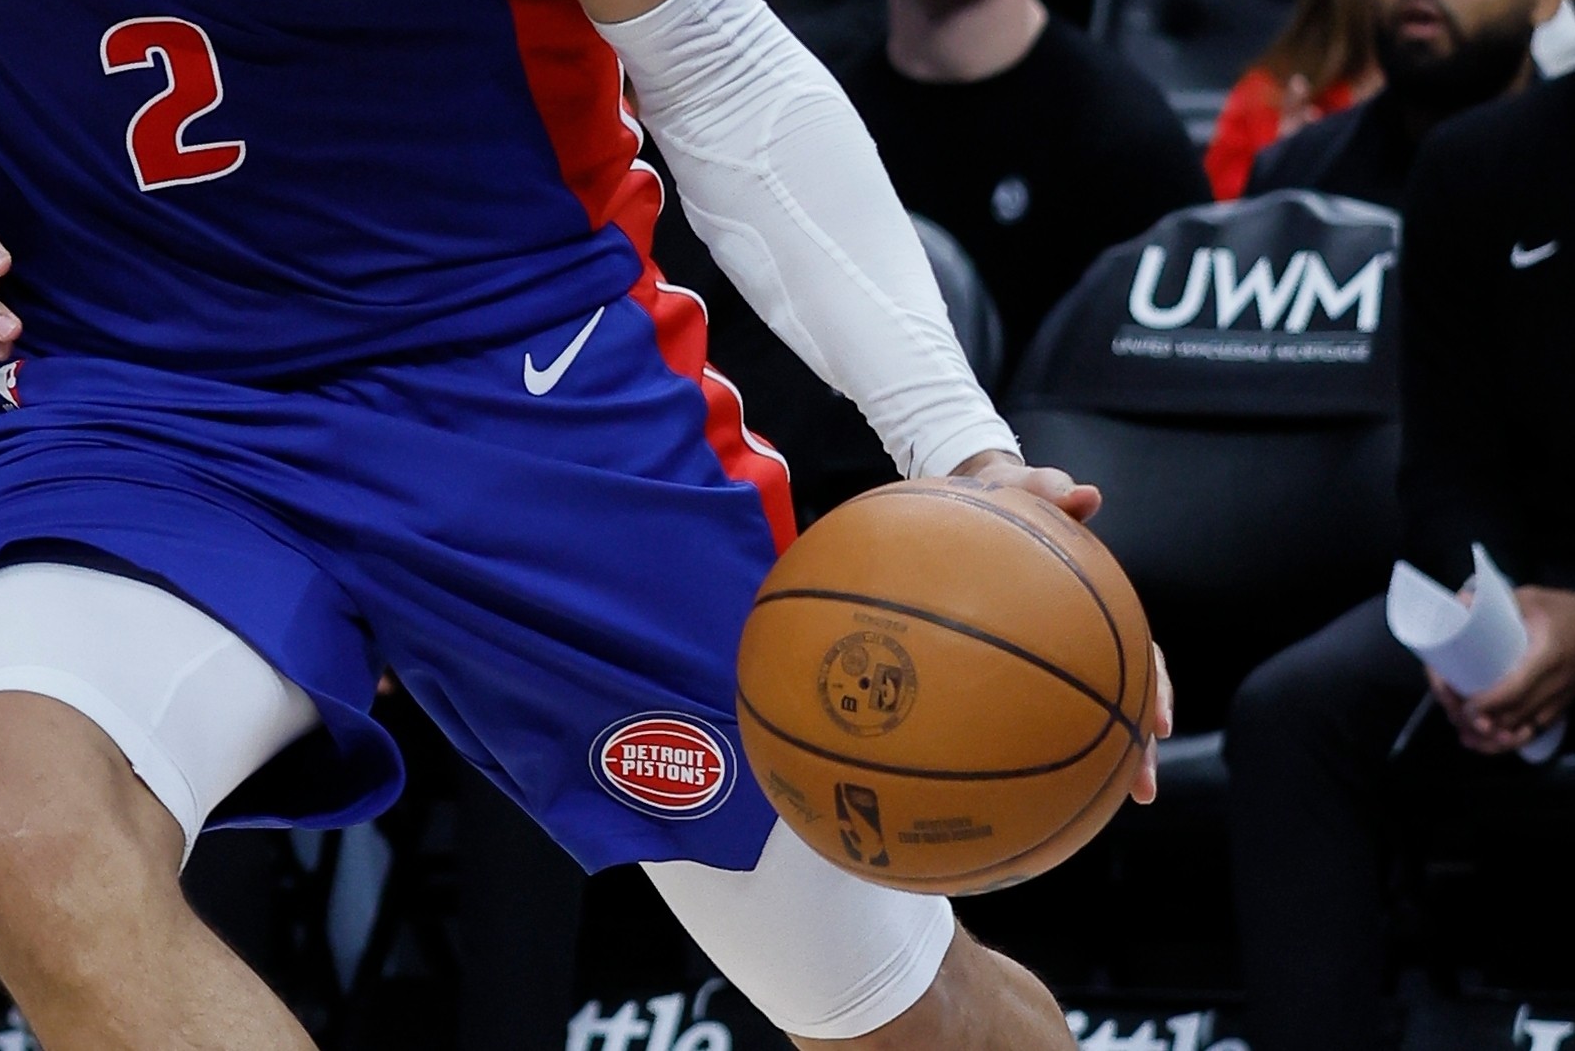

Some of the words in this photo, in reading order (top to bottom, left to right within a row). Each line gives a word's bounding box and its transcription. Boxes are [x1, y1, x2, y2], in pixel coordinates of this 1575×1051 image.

[99, 16, 247, 192] 2
[1128, 245, 1393, 334] UWM
[620, 760, 706, 786] PISTONS
[621, 744, 706, 767] DETROIT
[564, 992, 733, 1051] ttle
